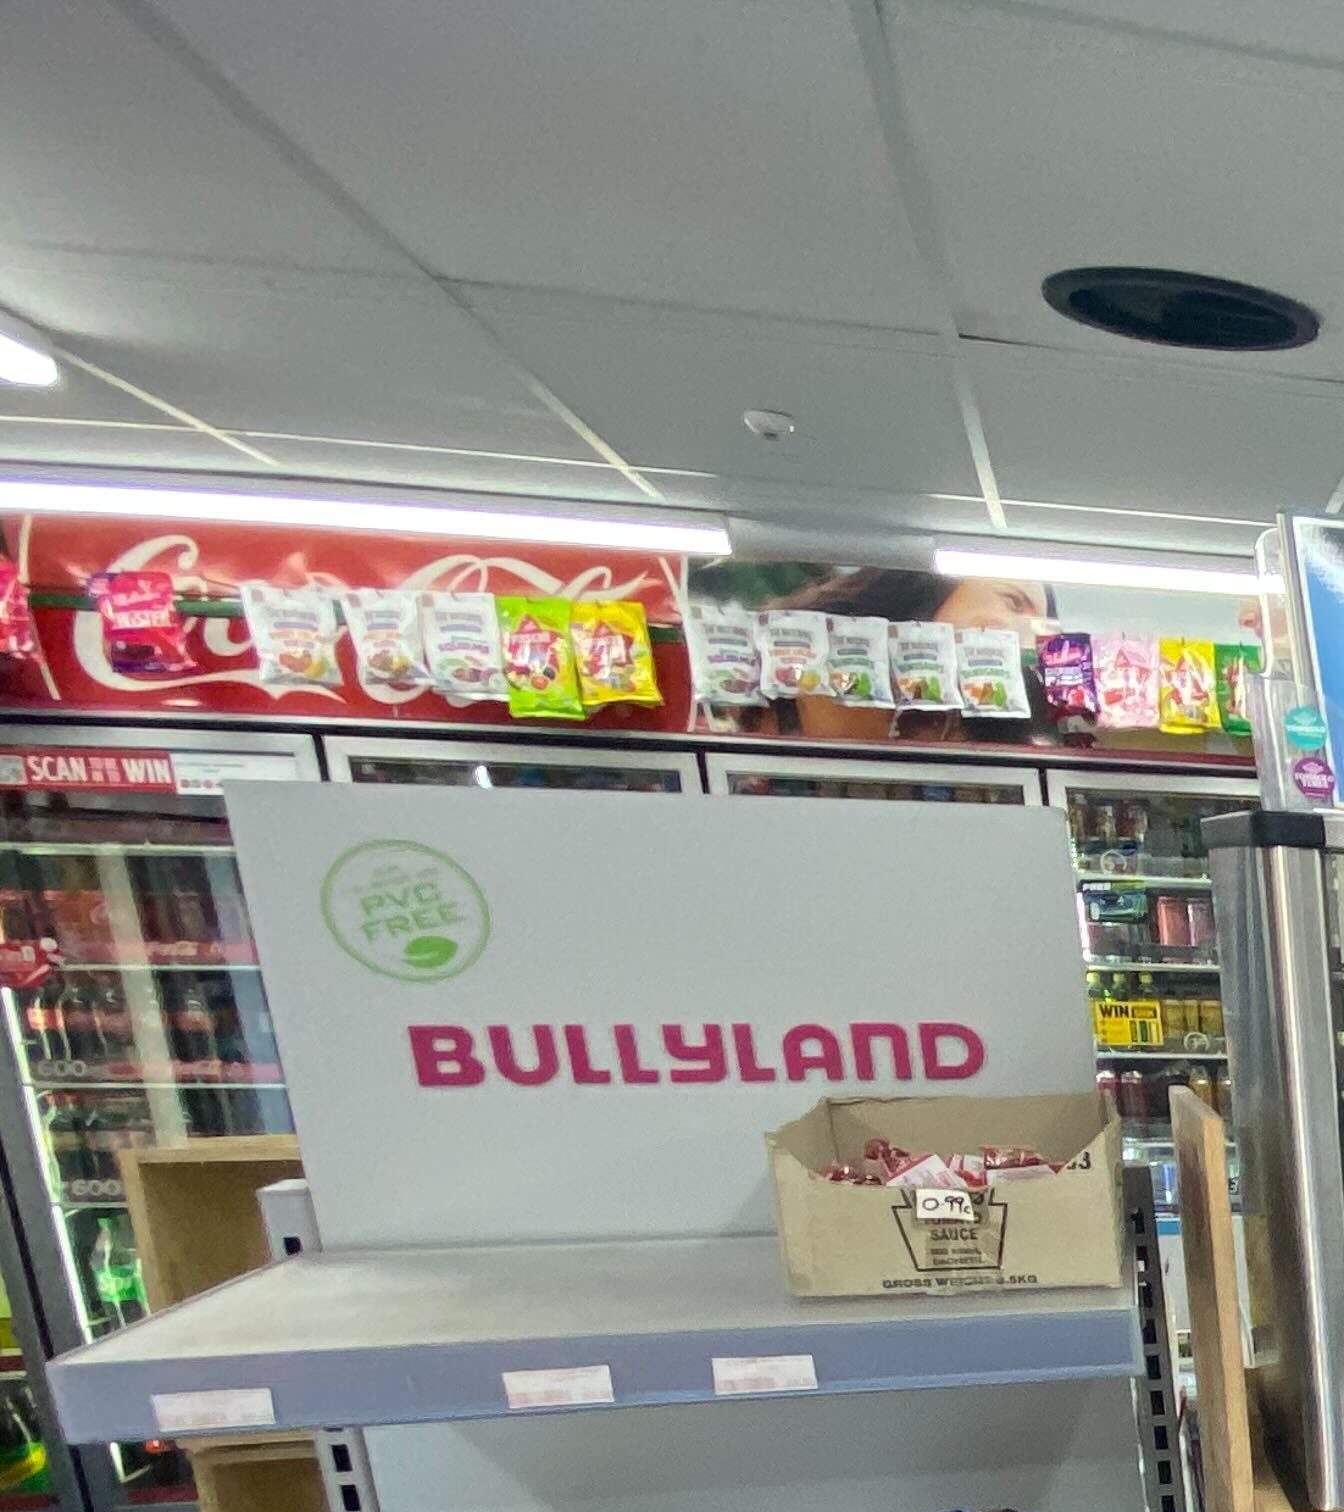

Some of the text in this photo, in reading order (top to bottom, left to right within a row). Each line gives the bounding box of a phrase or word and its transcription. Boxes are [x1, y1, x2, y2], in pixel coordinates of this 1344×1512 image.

[27, 756, 171, 785] SCAN WIN
[1100, 1004, 1129, 1017] WIN
[408, 1022, 985, 1088] BULLYLAND
[930, 1227, 978, 1241] SAUCE
